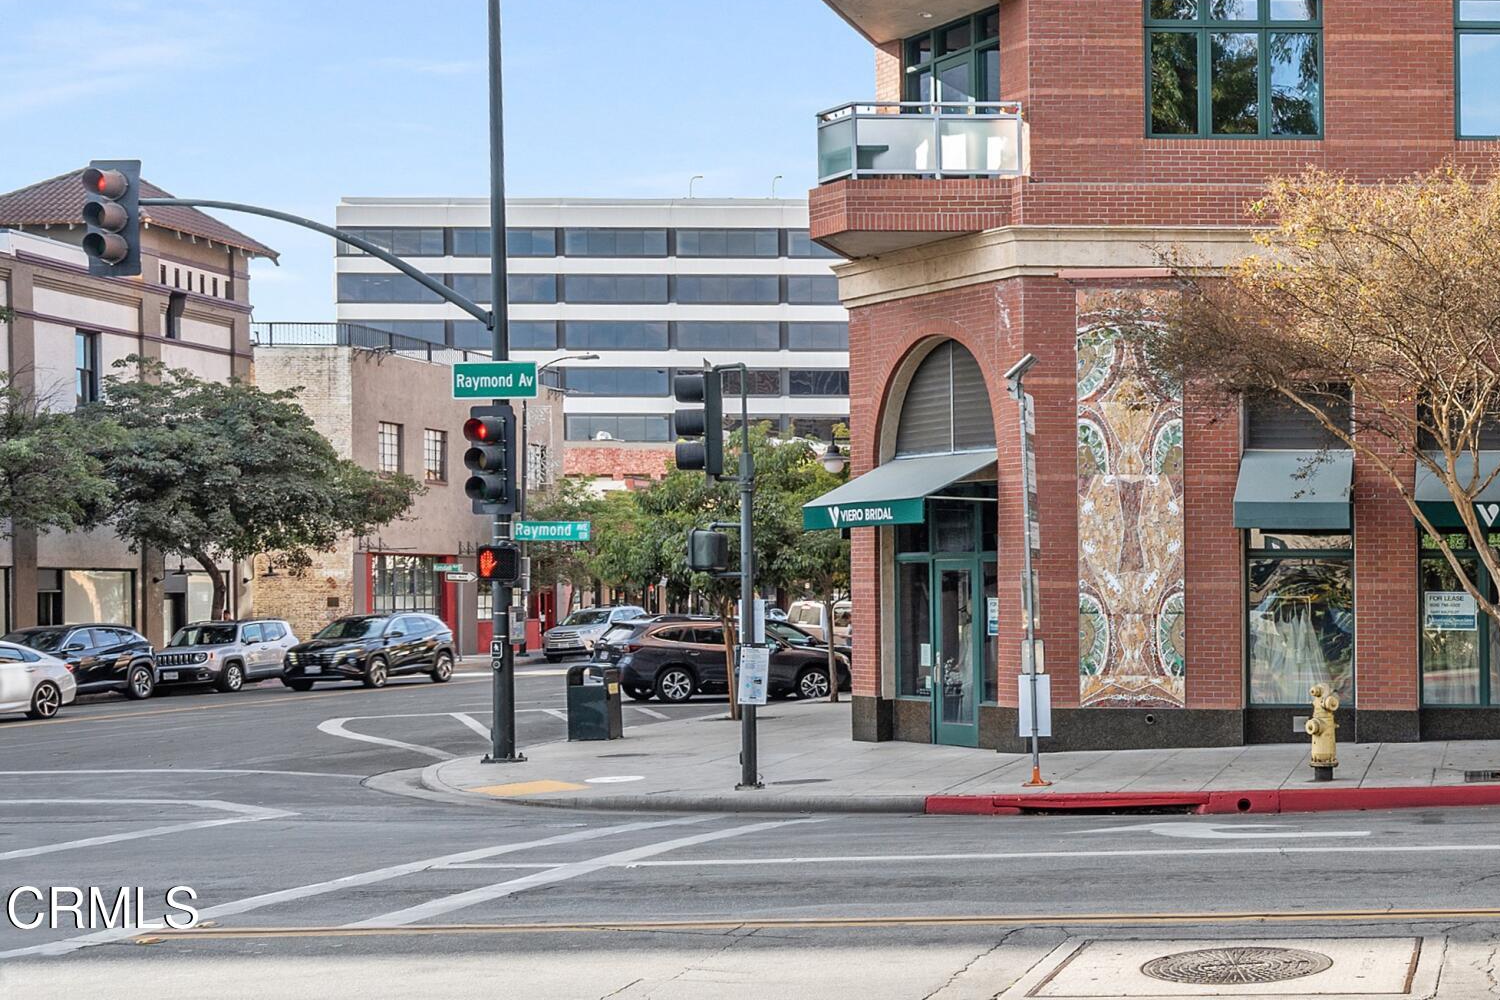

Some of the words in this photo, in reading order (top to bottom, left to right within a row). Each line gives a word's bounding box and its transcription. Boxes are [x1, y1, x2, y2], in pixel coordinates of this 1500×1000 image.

[456, 374, 513, 391] Raymond
[518, 373, 534, 387] Av
[840, 508, 863, 522] VIERO
[865, 507, 893, 520] BRIDAL
[515, 523, 572, 539] Raymond
